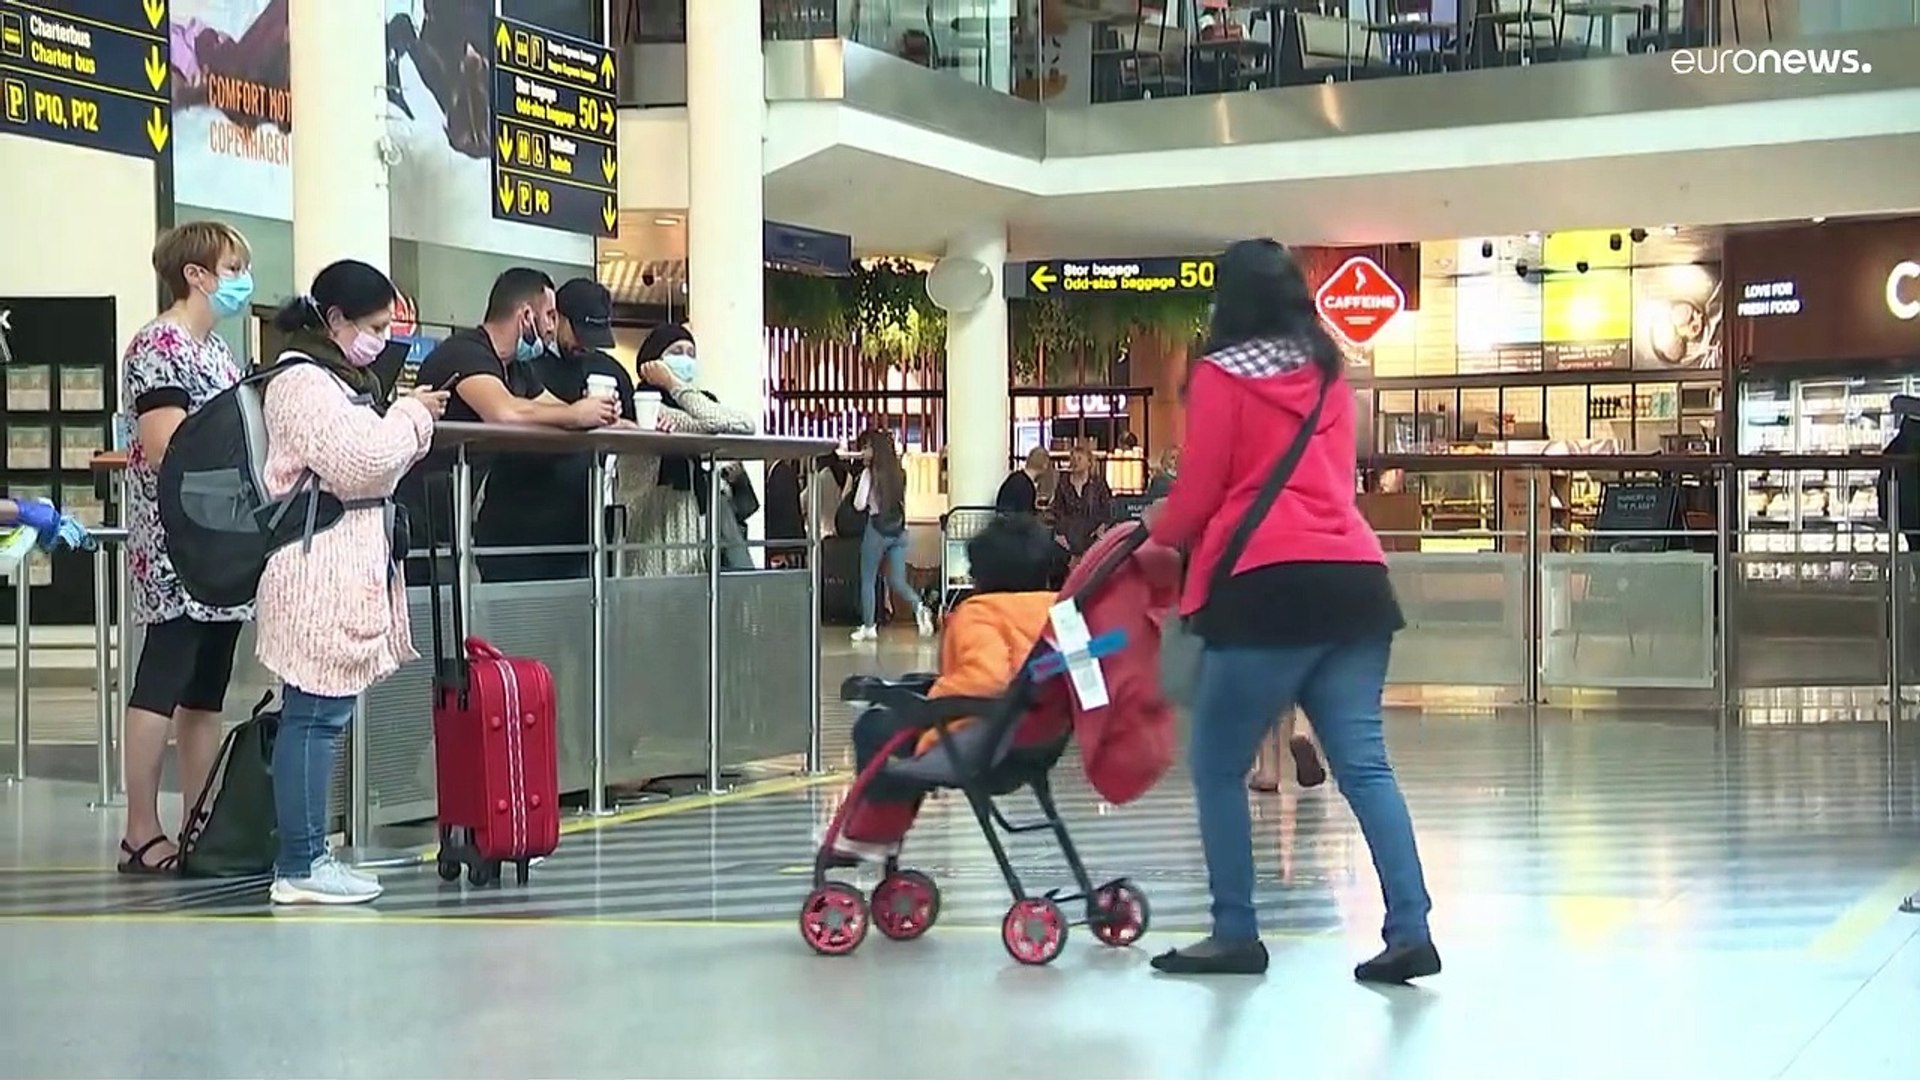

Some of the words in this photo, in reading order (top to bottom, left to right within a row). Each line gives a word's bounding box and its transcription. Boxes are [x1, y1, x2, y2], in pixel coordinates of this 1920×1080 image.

[30, 14, 91, 49] Charterbus
[31, 41, 73, 70] Charter
[75, 50, 96, 74] bus
[208, 73, 267, 117] COMFORT
[34, 91, 69, 130] P10,
[72, 101, 99, 132] P12
[579, 95, 599, 131] 50
[209, 121, 289, 166] COPENHAGEN
[535, 189, 550, 214] P8
[1063, 263, 1089, 277] Stor
[1092, 262, 1140, 278] bagage
[1063, 277, 1117, 290] Odd-size
[1121, 277, 1176, 290] baggage
[1180, 261, 1215, 288] 50
[1323, 294, 1397, 310] CAFFEINE
[1744, 284, 1771, 299] LOVE
[1771, 282, 1794, 297] FOR
[1737, 301, 1770, 316] FRESH
[1770, 299, 1800, 315] FOOD
